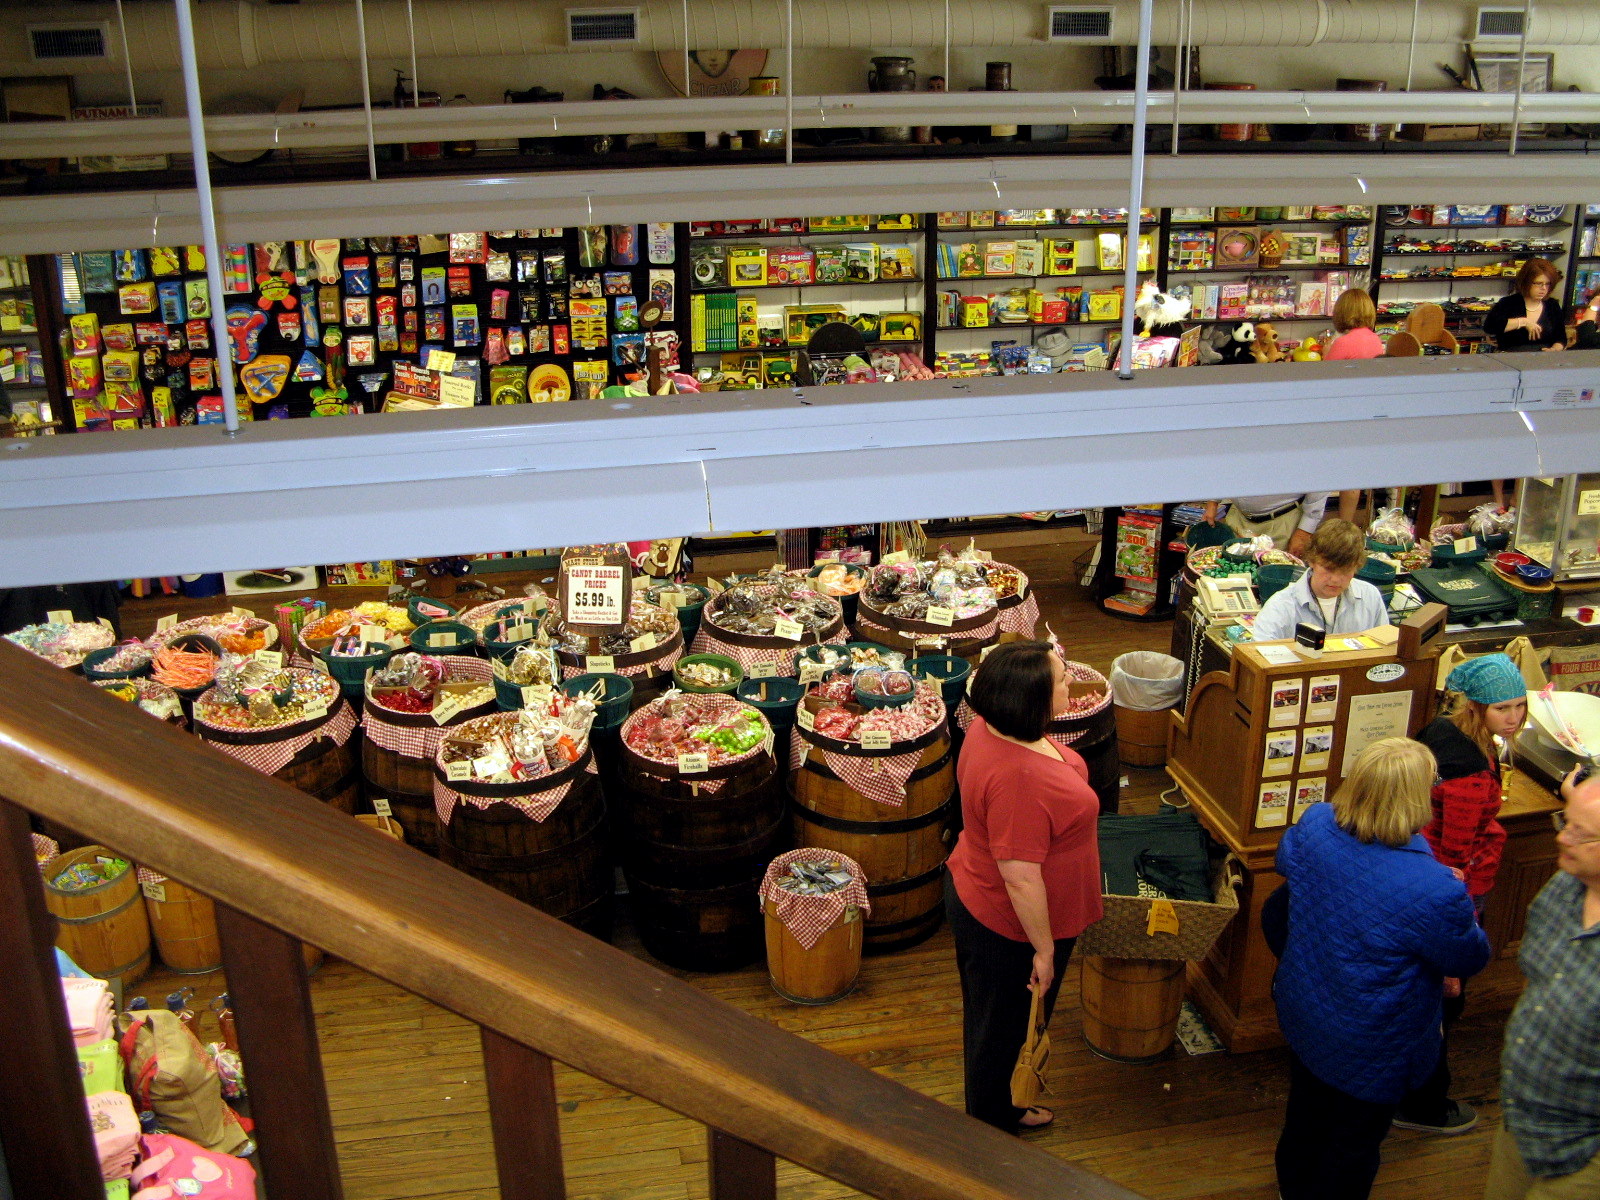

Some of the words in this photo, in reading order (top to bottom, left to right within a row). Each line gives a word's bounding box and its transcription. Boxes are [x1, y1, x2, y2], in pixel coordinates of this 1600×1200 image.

[689, 78, 742, 97] CIGAR
[75, 107, 128, 119] PUTNAM
[1530, 213, 1556, 223] PARTS
[379, 306, 393, 315] UNO
[571, 569, 593, 578] CANDY
[595, 569, 620, 578] BARREL
[584, 580, 607, 588] PRICES
[575, 592, 604, 607] $5.99
[606, 596, 616, 607] lb.
[1385, 663, 1402, 671] STORE
[1561, 663, 1580, 673] FOUR
[1581, 661, 1600, 672] BELLS
